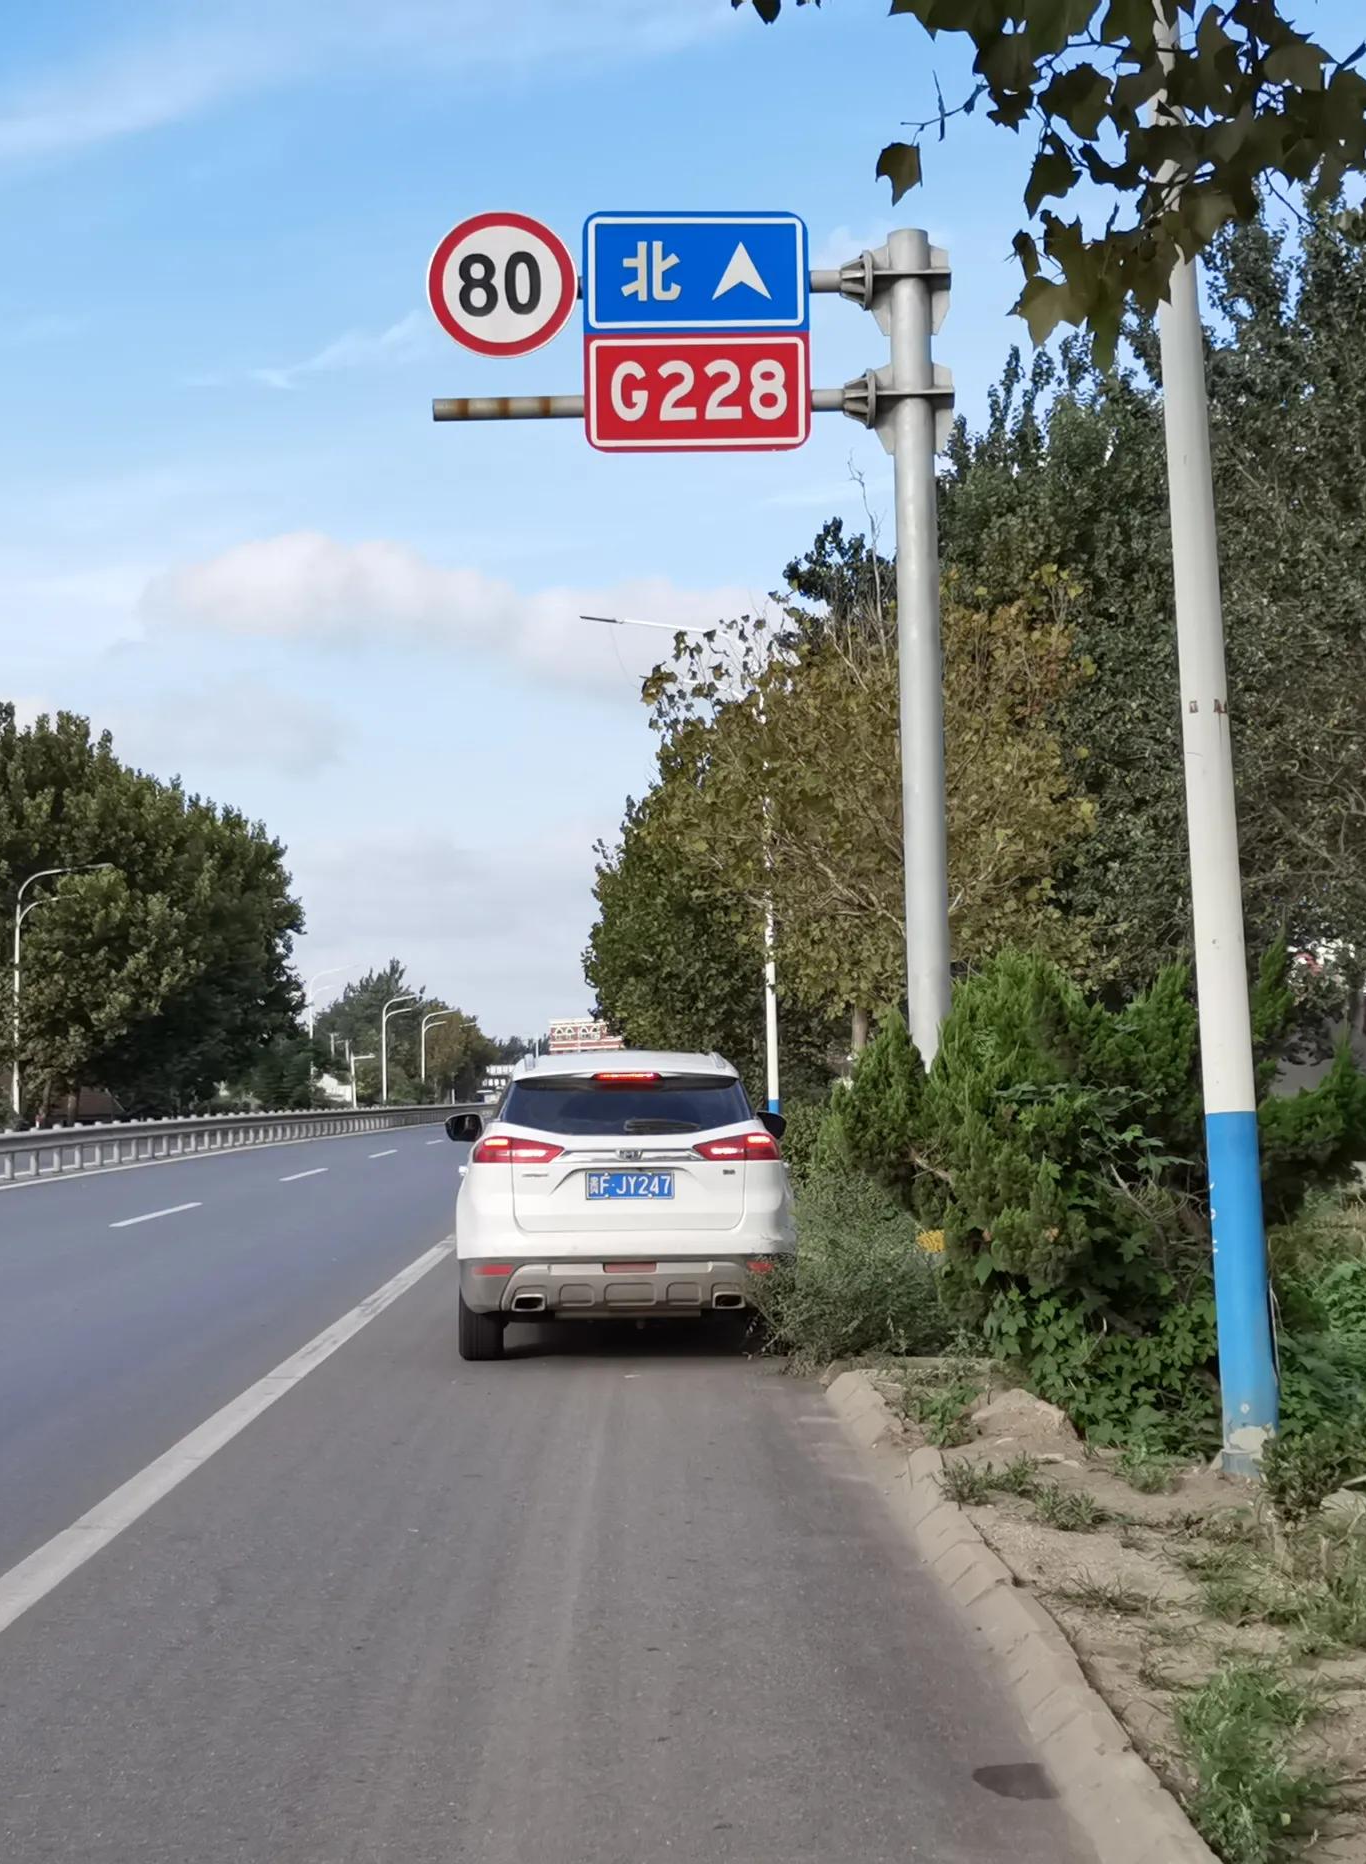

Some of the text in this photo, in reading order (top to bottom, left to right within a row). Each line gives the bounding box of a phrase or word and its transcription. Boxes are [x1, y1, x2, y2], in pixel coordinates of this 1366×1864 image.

[458, 251, 542, 317] 80
[621, 240, 682, 302] 北
[610, 359, 788, 422] G228
